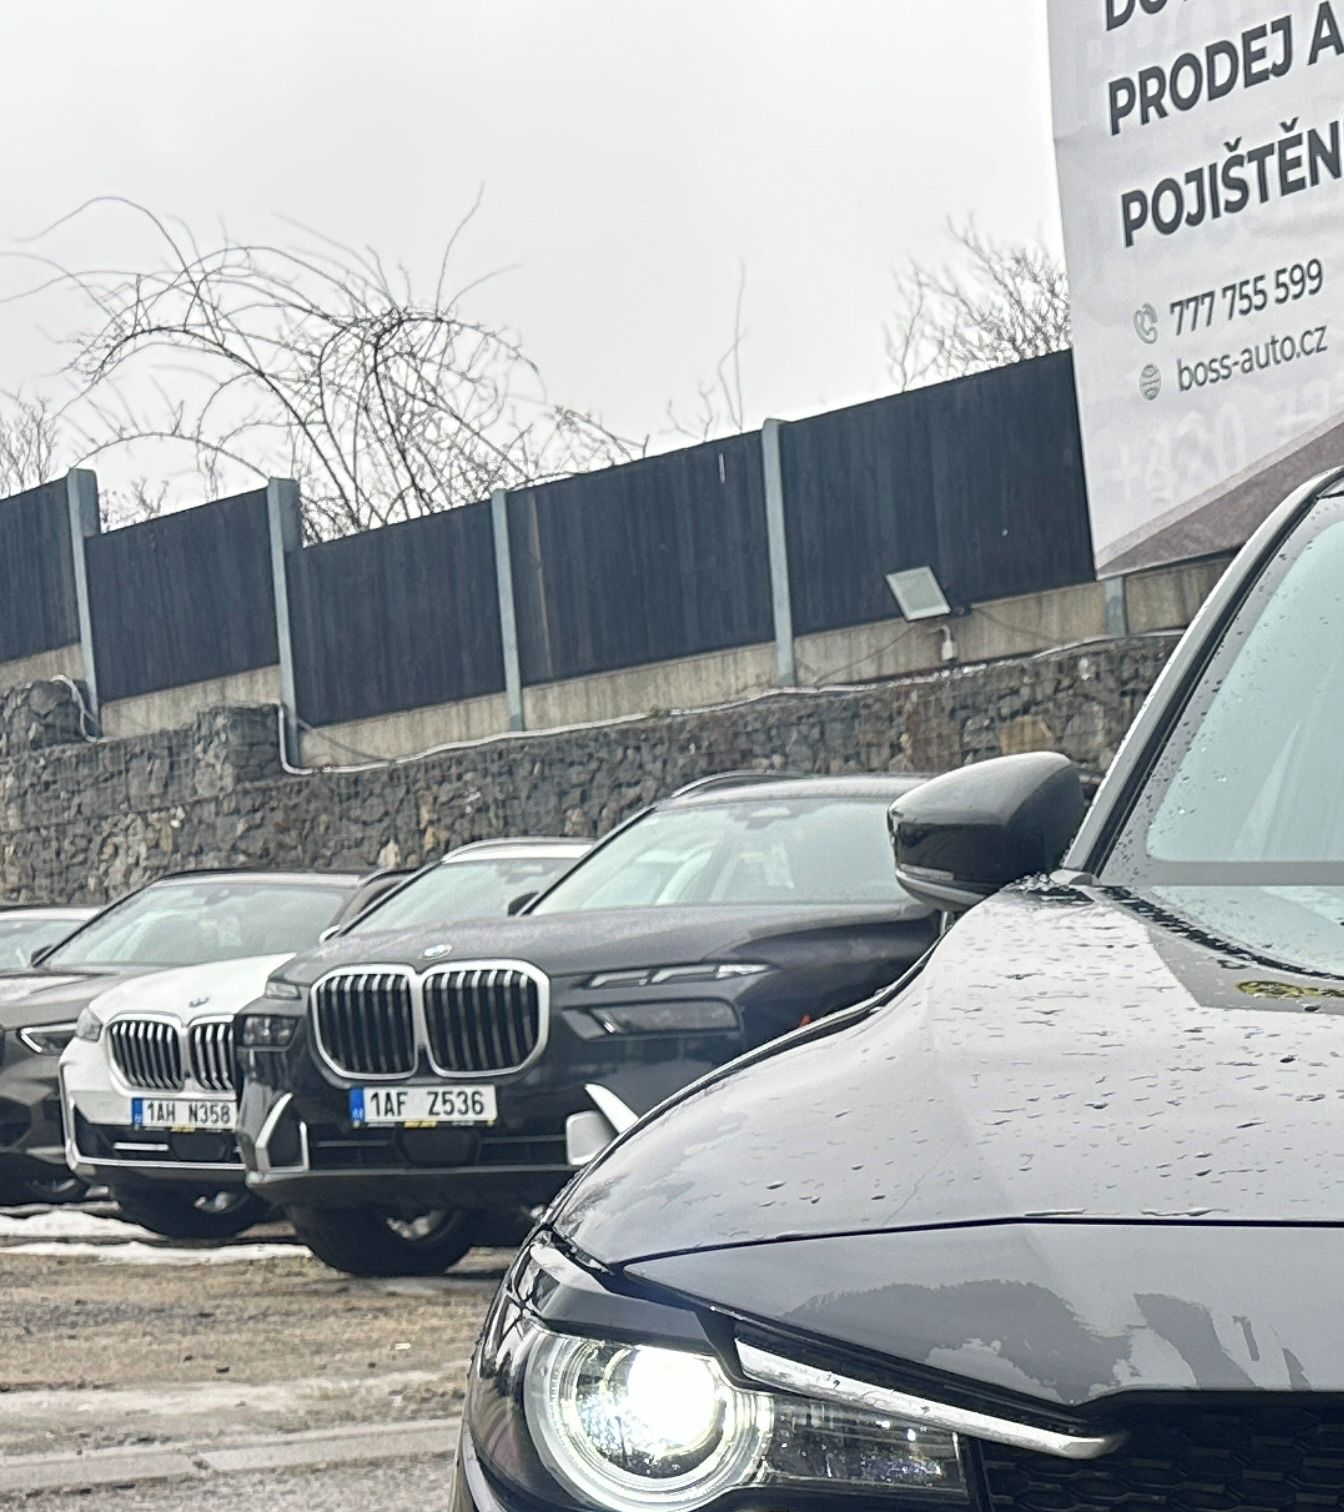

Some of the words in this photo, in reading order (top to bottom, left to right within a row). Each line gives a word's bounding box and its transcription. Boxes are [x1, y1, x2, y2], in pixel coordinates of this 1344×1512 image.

[1109, 15, 1293, 135] PRODEJ
[1170, 291, 1215, 336] 777
[1222, 274, 1267, 321] 755
[1274, 258, 1323, 304] 599
[1176, 325, 1329, 392] boss-auto.cz
[147, 1102, 176, 1122] 1AH
[370, 1092, 408, 1117] 1AF
[427, 1090, 485, 1116] Z536
